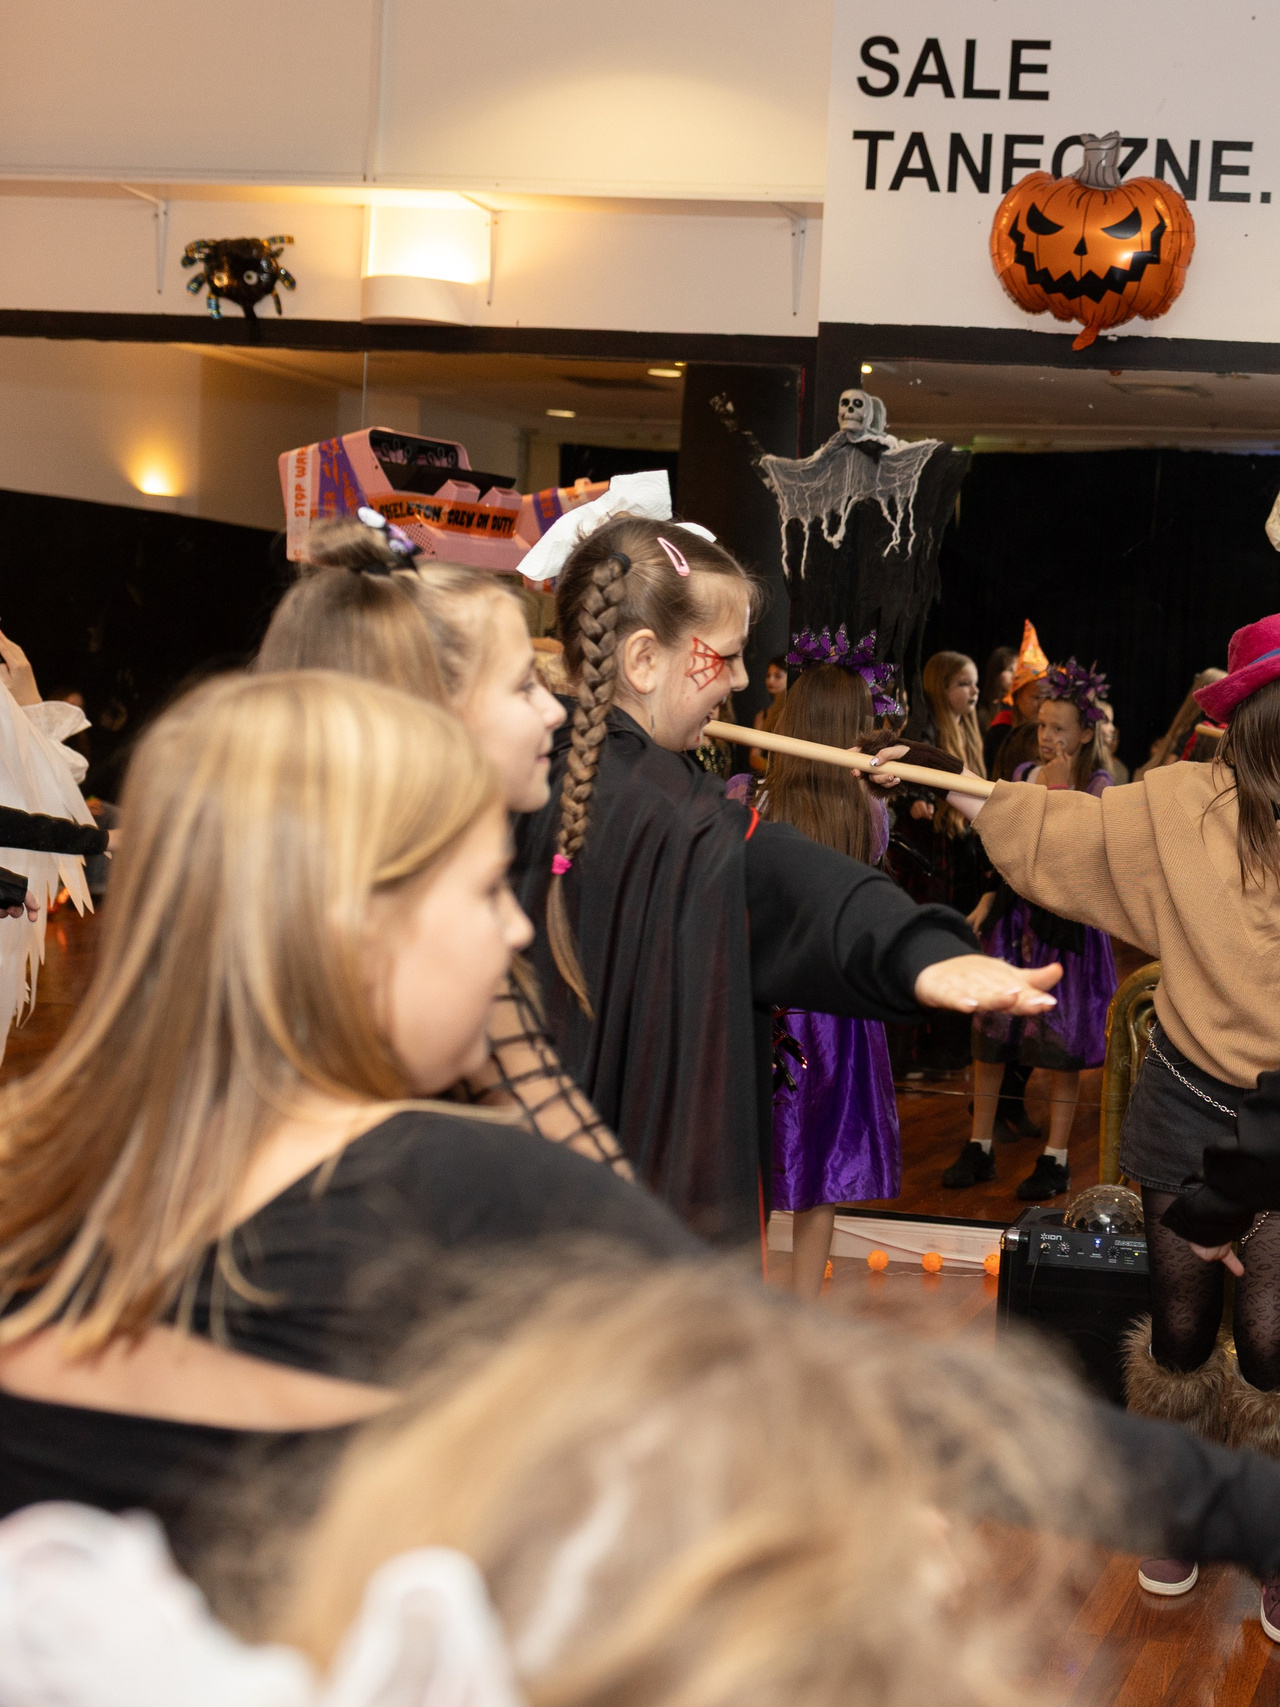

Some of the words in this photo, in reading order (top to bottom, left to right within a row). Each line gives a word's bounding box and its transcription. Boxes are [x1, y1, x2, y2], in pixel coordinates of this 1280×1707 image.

[857, 36, 1052, 101] SALE
[295, 483, 306, 518] STOP
[379, 501, 442, 522] SKELETON
[447, 509, 476, 528] CREW
[476, 513, 490, 530] ON
[491, 515, 515, 533] DUTY
